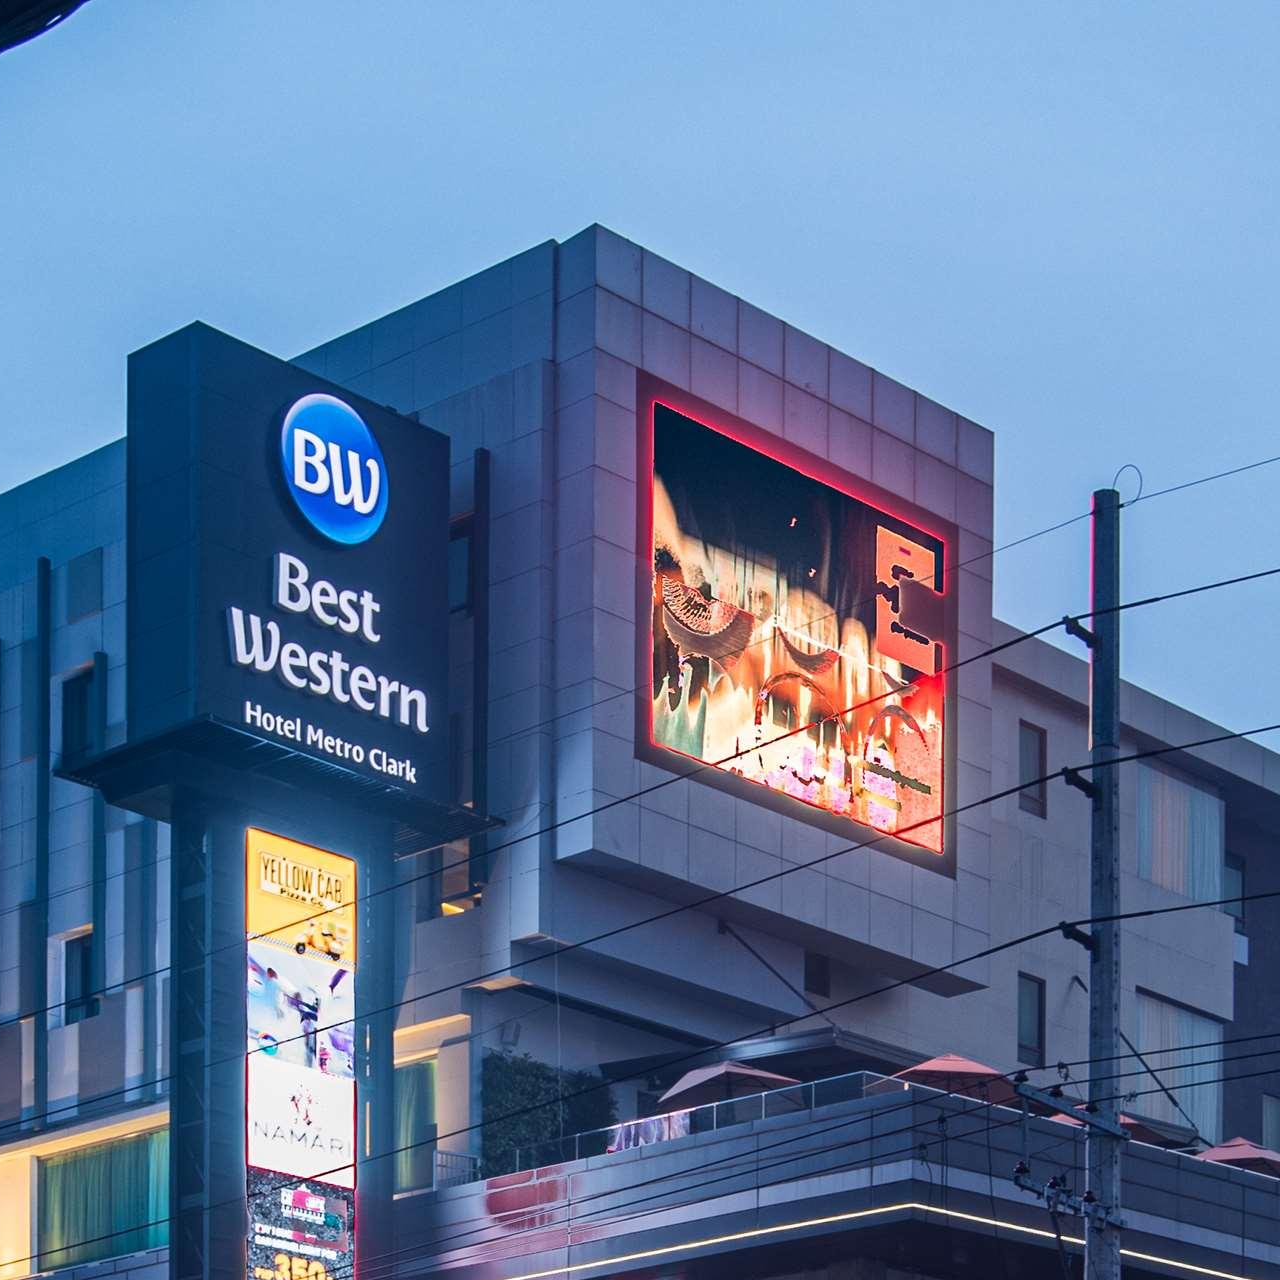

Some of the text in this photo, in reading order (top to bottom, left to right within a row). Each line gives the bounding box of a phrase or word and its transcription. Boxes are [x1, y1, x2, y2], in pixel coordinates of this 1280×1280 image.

[293, 427, 381, 515] BW
[276, 551, 382, 644] Best
[228, 606, 430, 734] Western
[245, 700, 417, 784] Hotel Metro Clark
[261, 856, 343, 904] YELLOW CAB
